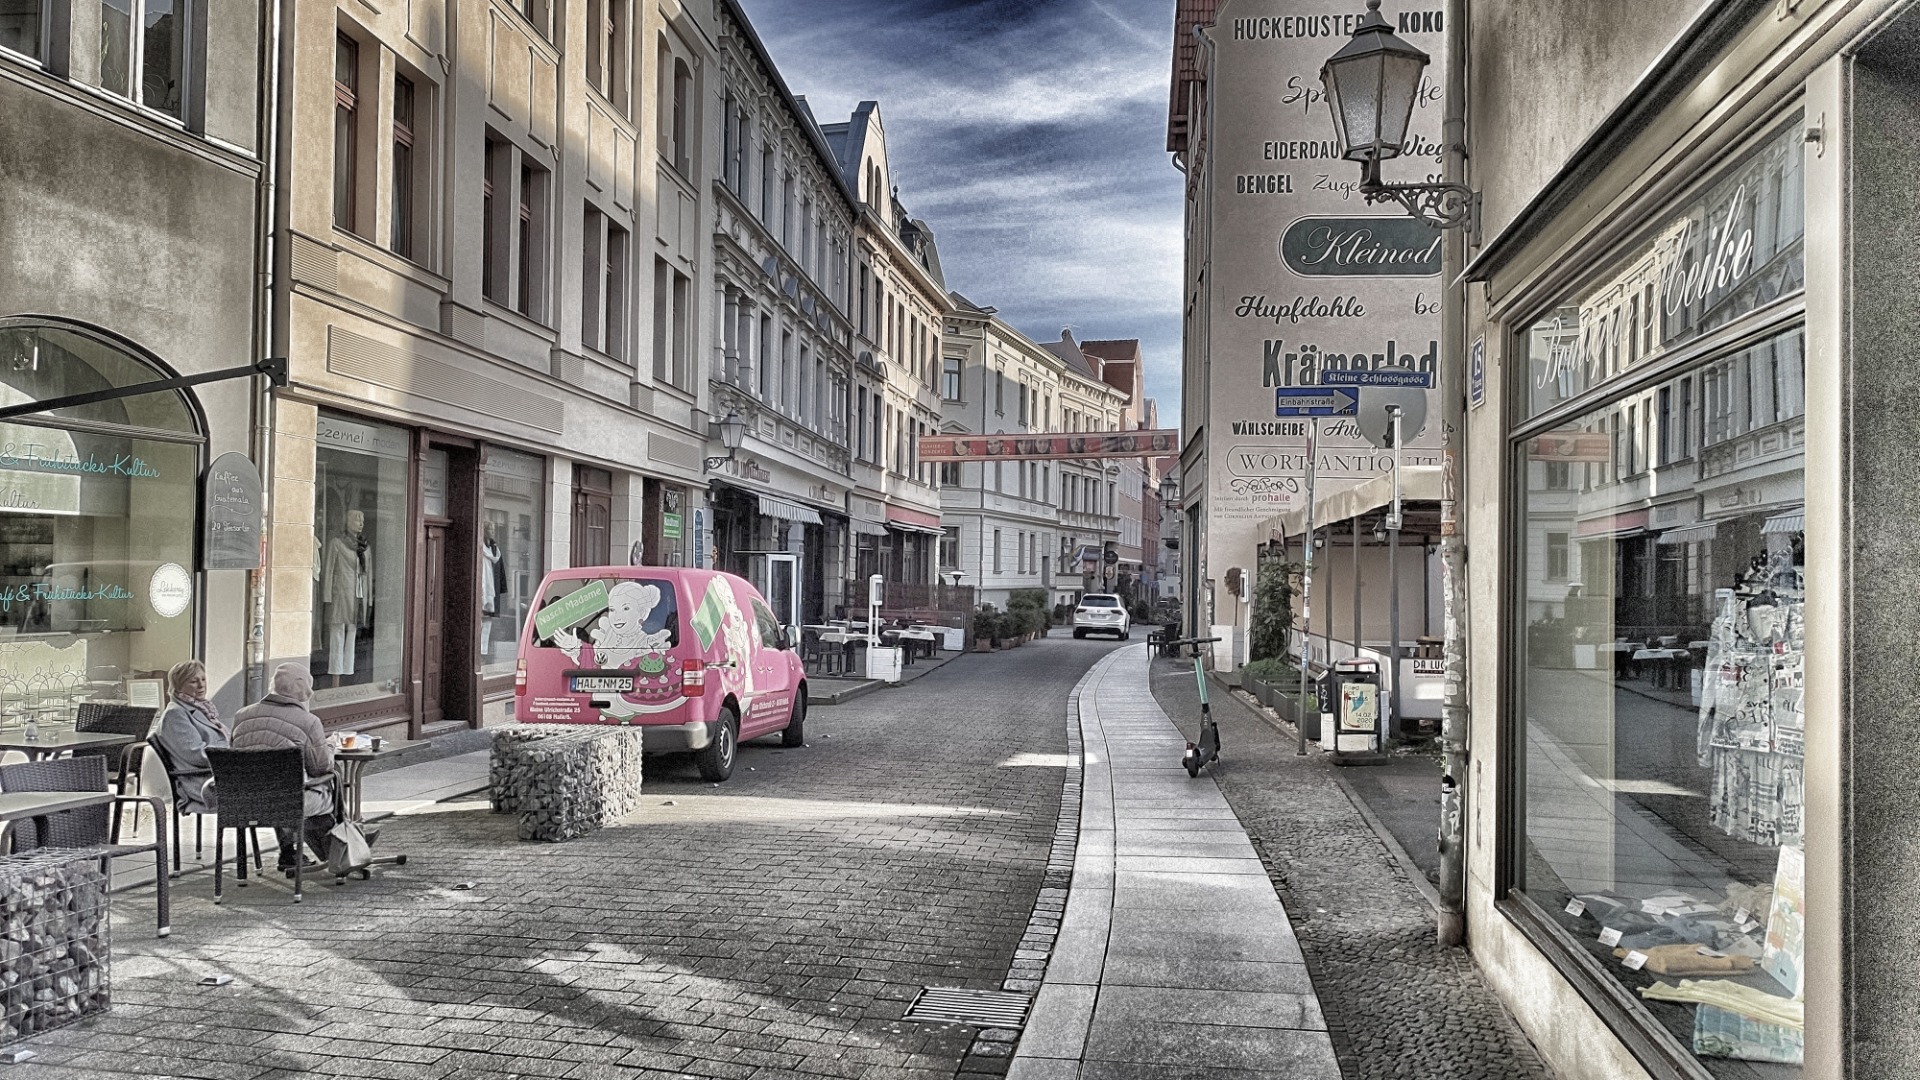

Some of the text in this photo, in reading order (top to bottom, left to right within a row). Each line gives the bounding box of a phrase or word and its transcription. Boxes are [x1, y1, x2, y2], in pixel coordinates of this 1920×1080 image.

[1236, 174, 1293, 194] BENGEL
[1300, 225, 1442, 266] Kleinod
[1643, 184, 1753, 330] Heike
[1235, 295, 1366, 324] Hupfdohle
[1328, 371, 1425, 385] Kleine Schlossgasse
[1280, 397, 1335, 406] Einbahnstraße
[317, 421, 364, 444] Czernei
[1232, 419, 1305, 436] WÄHLSCHEIBE
[0, 442, 160, 477] & Frühstücks-Kultur
[1240, 454, 1308, 470] WORT
[214, 471, 239, 485] Kaffee
[1251, 493, 1291, 504] prohalle
[211, 520, 221, 531] 20
[15, 584, 30, 602] &
[539, 606, 564, 626] Nasch
[564, 587, 602, 611] Madame
[1413, 660, 1426, 669] DA
[576, 678, 632, 689] HAL NM 25
